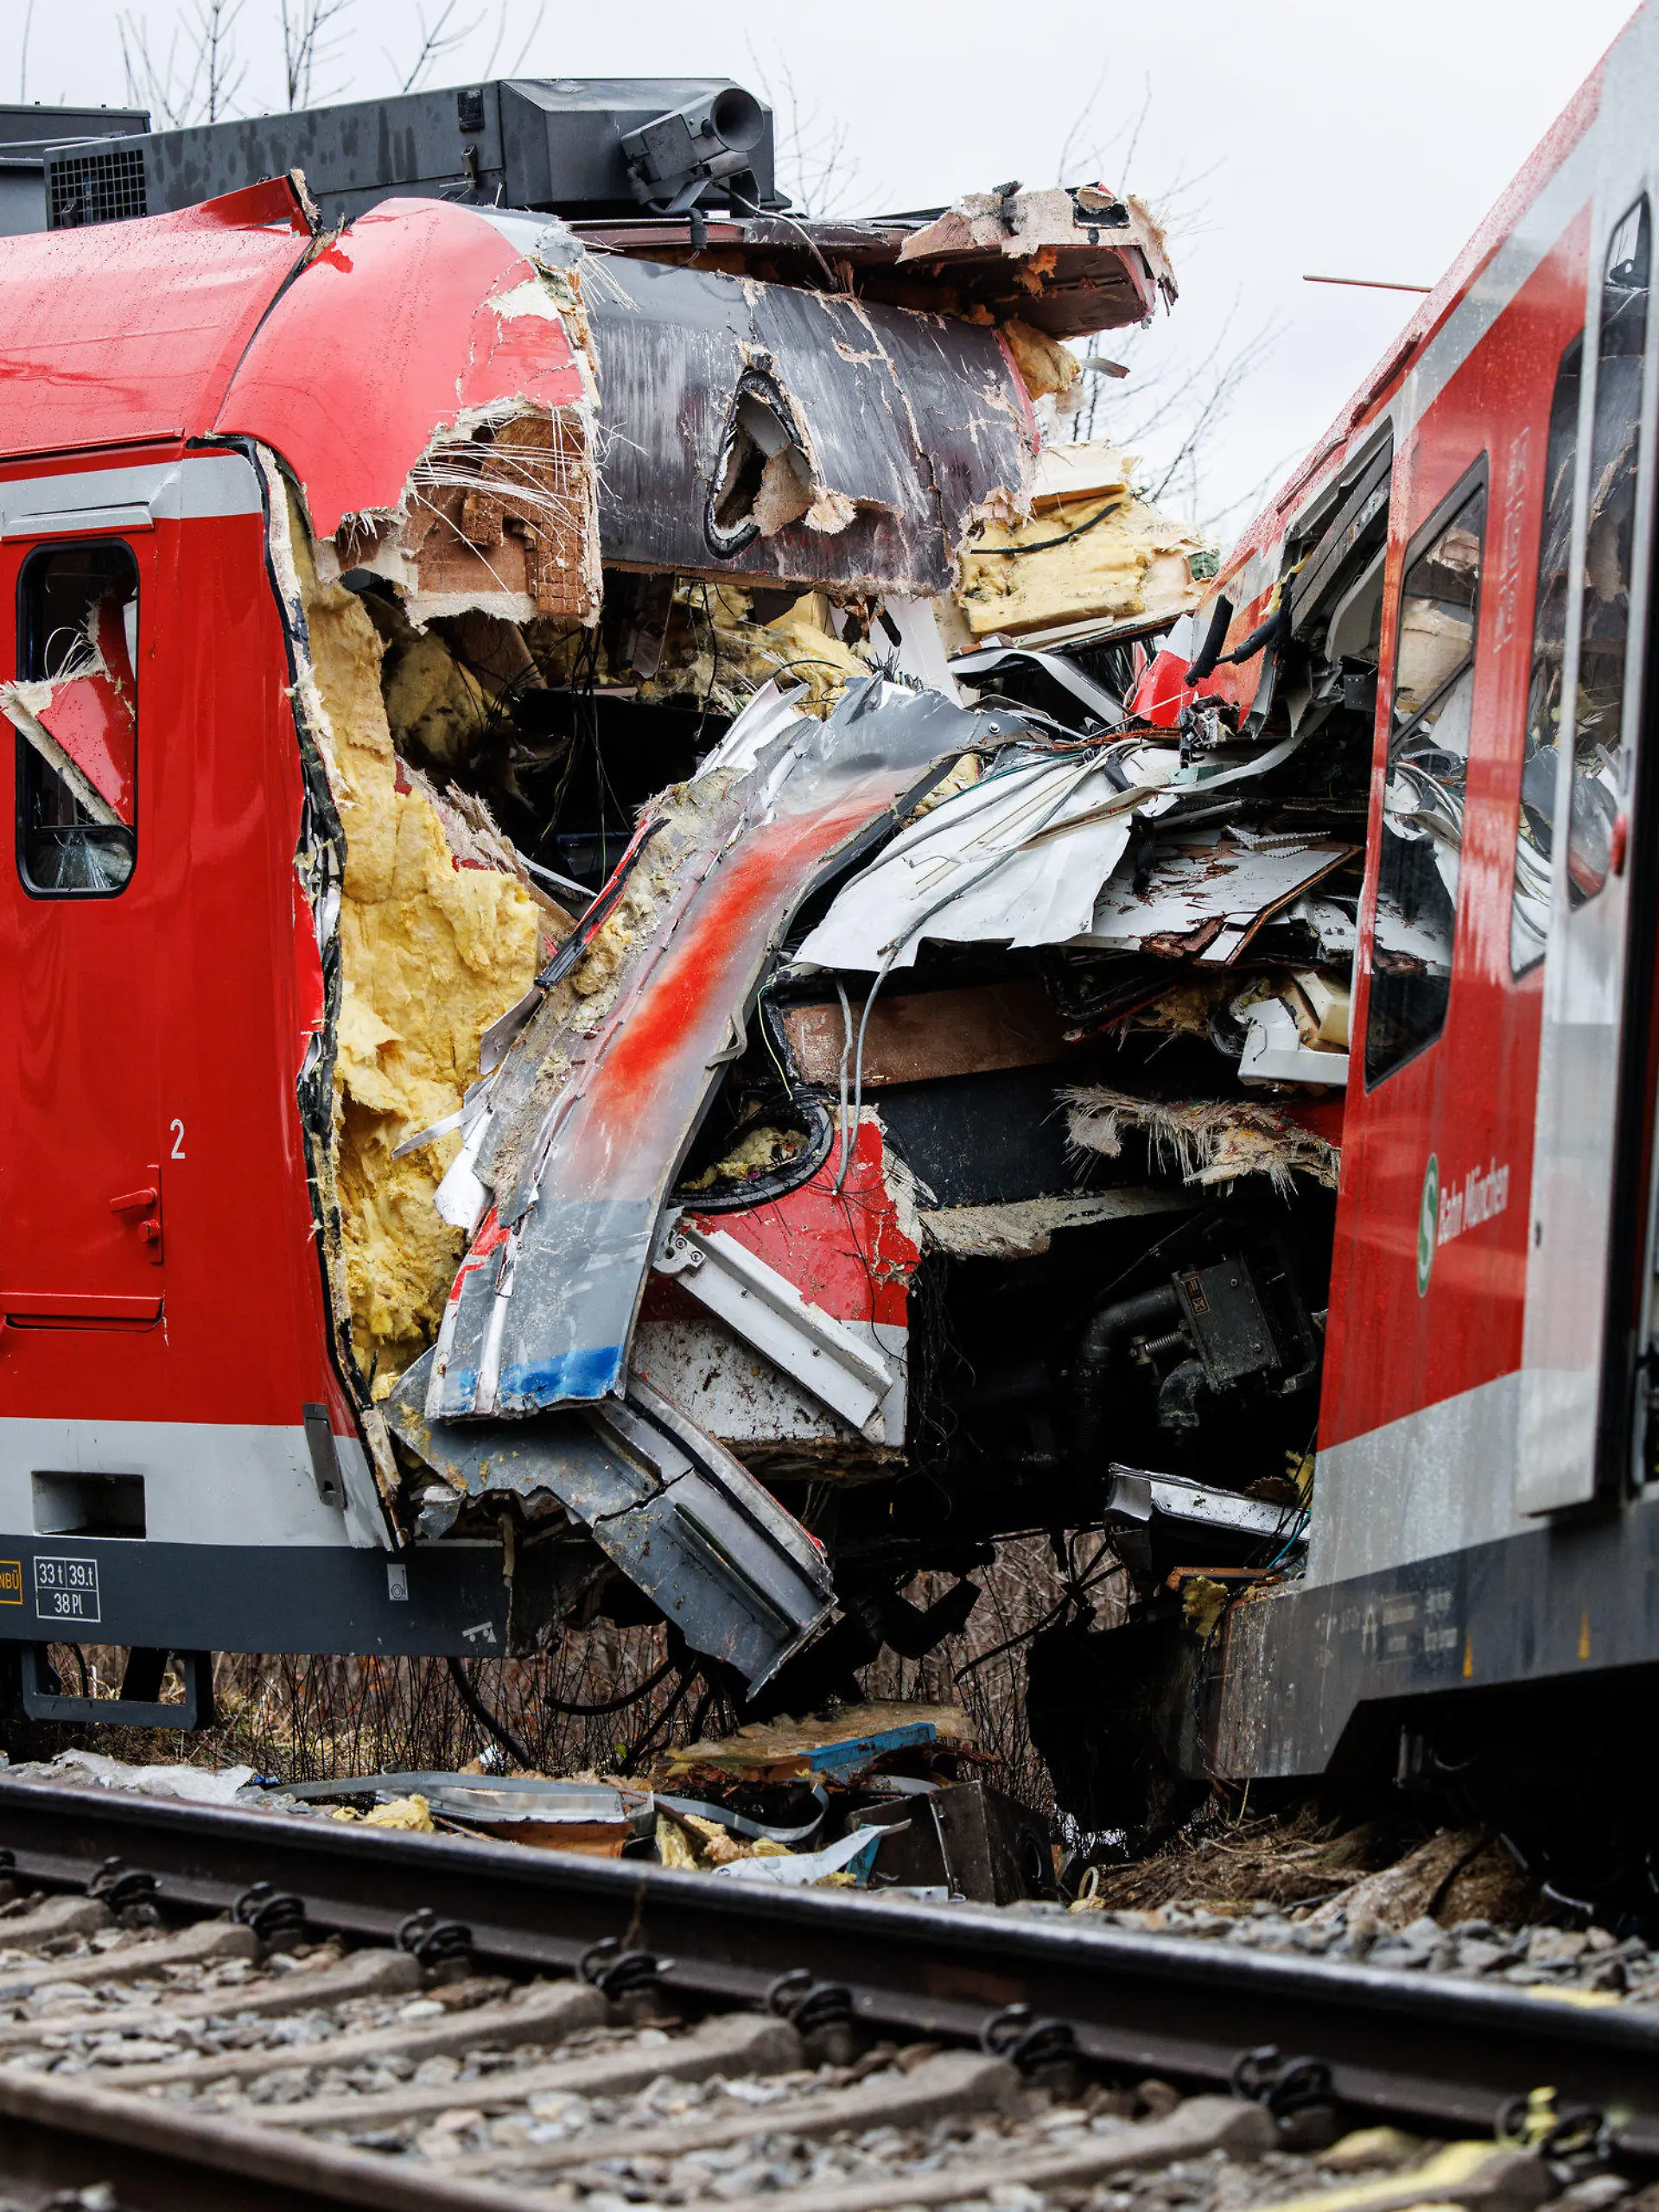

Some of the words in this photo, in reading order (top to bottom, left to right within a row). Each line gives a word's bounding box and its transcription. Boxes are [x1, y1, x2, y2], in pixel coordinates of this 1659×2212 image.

[170, 1118, 186, 1160] 2
[1419, 1169, 1437, 1281] S
[39, 1562, 55, 1585] 33
[57, 1565, 64, 1585] t
[54, 1592, 71, 1614] 38
